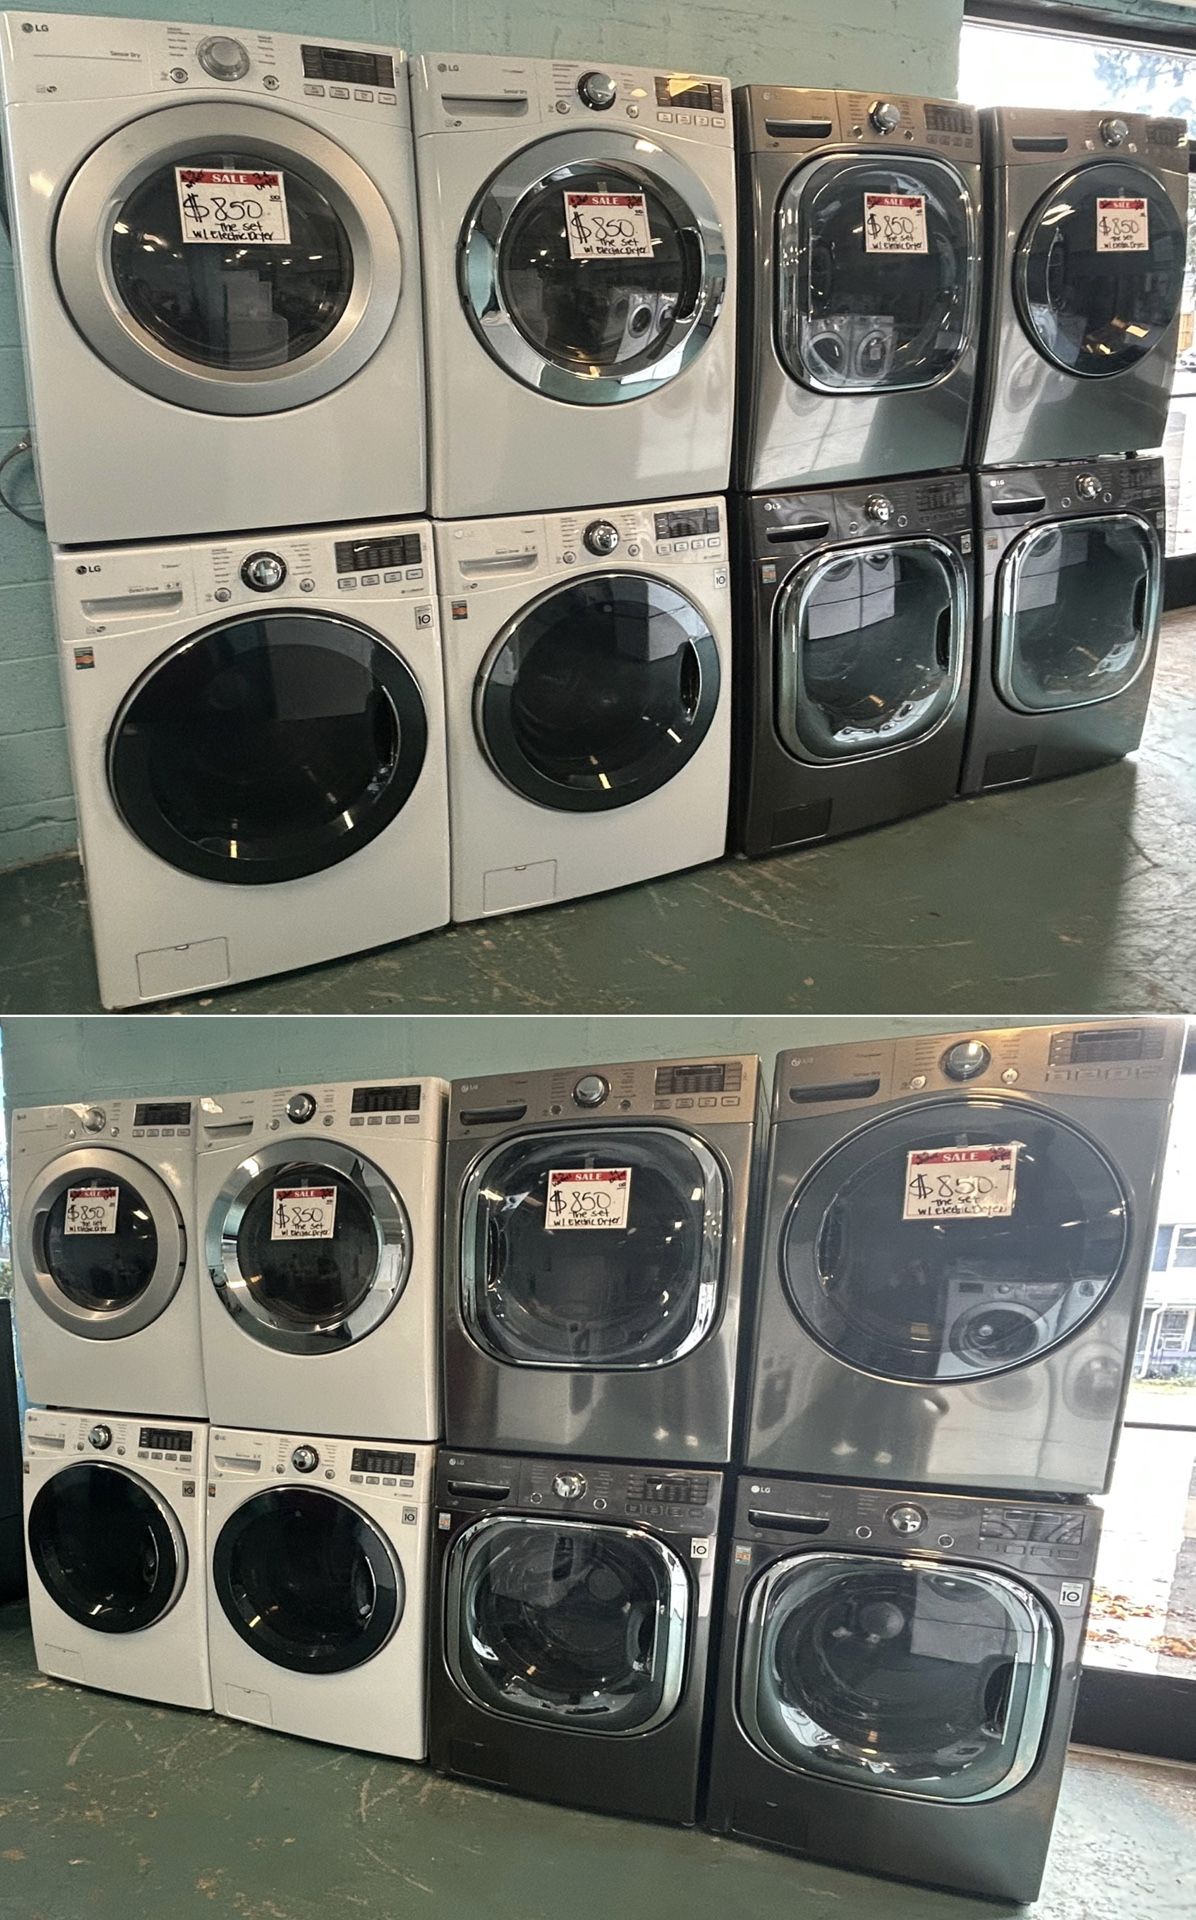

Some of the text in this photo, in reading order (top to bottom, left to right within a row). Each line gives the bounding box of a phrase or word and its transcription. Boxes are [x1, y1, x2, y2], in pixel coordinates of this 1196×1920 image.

[35, 24, 49, 32] LG
[212, 173, 248, 183] SALE
[418, 614, 431, 624] 10
[943, 1152, 979, 1162] SALE
[693, 1545, 707, 1555] 10
[1062, 1591, 1080, 1602] 10
